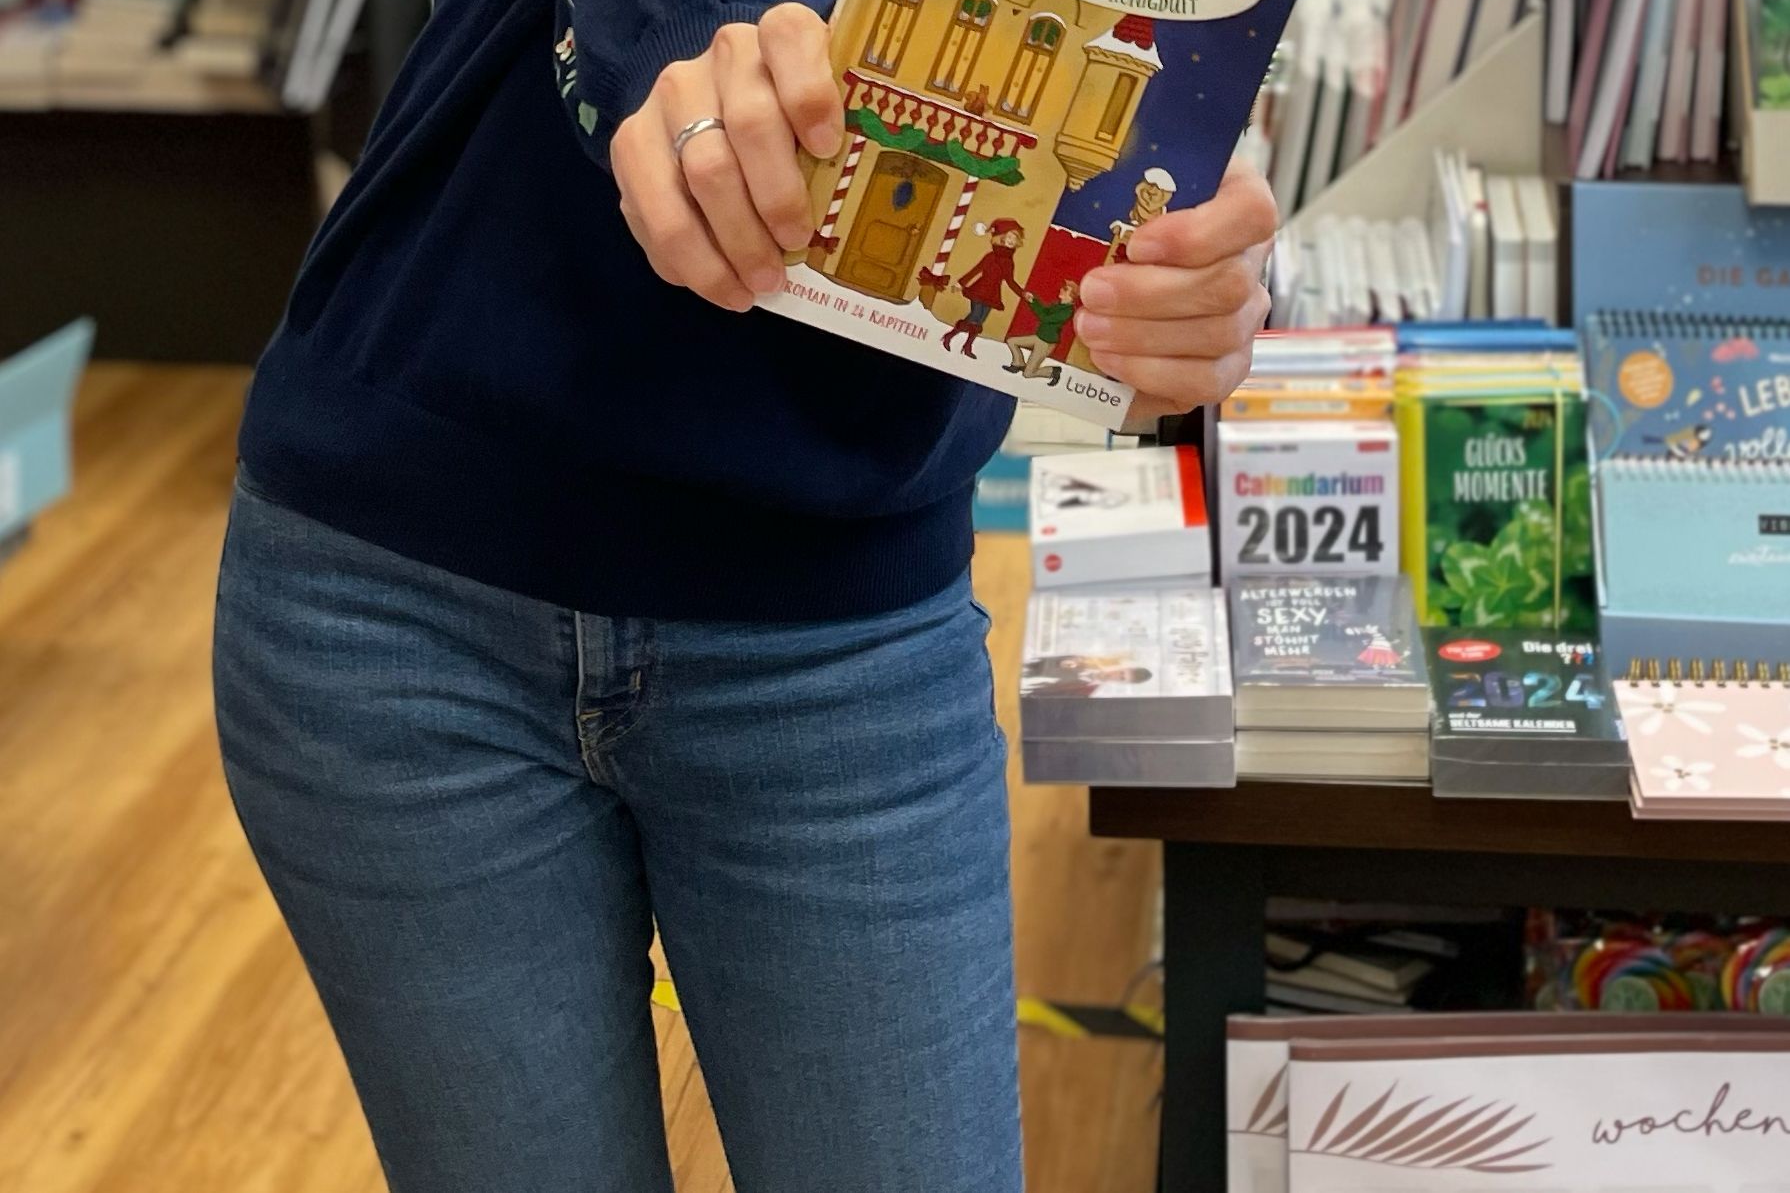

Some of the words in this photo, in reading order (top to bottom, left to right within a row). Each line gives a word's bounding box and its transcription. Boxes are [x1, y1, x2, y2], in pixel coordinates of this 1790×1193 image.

[1696, 263, 1744, 287] DIE
[783, 280, 831, 307] ROMAN
[833, 296, 849, 312] IN
[868, 309, 929, 341] KAPITELN
[1464, 432, 1527, 468] GLÜCKS
[1234, 471, 1385, 497] Calendarium
[1453, 469, 1548, 503] MOMENTE
[1236, 504, 1385, 565] 2024
[1522, 640, 1553, 654] Die
[1555, 640, 1594, 655] drei
[1448, 671, 1606, 710] 2024
[1591, 1081, 1790, 1145] wochen
